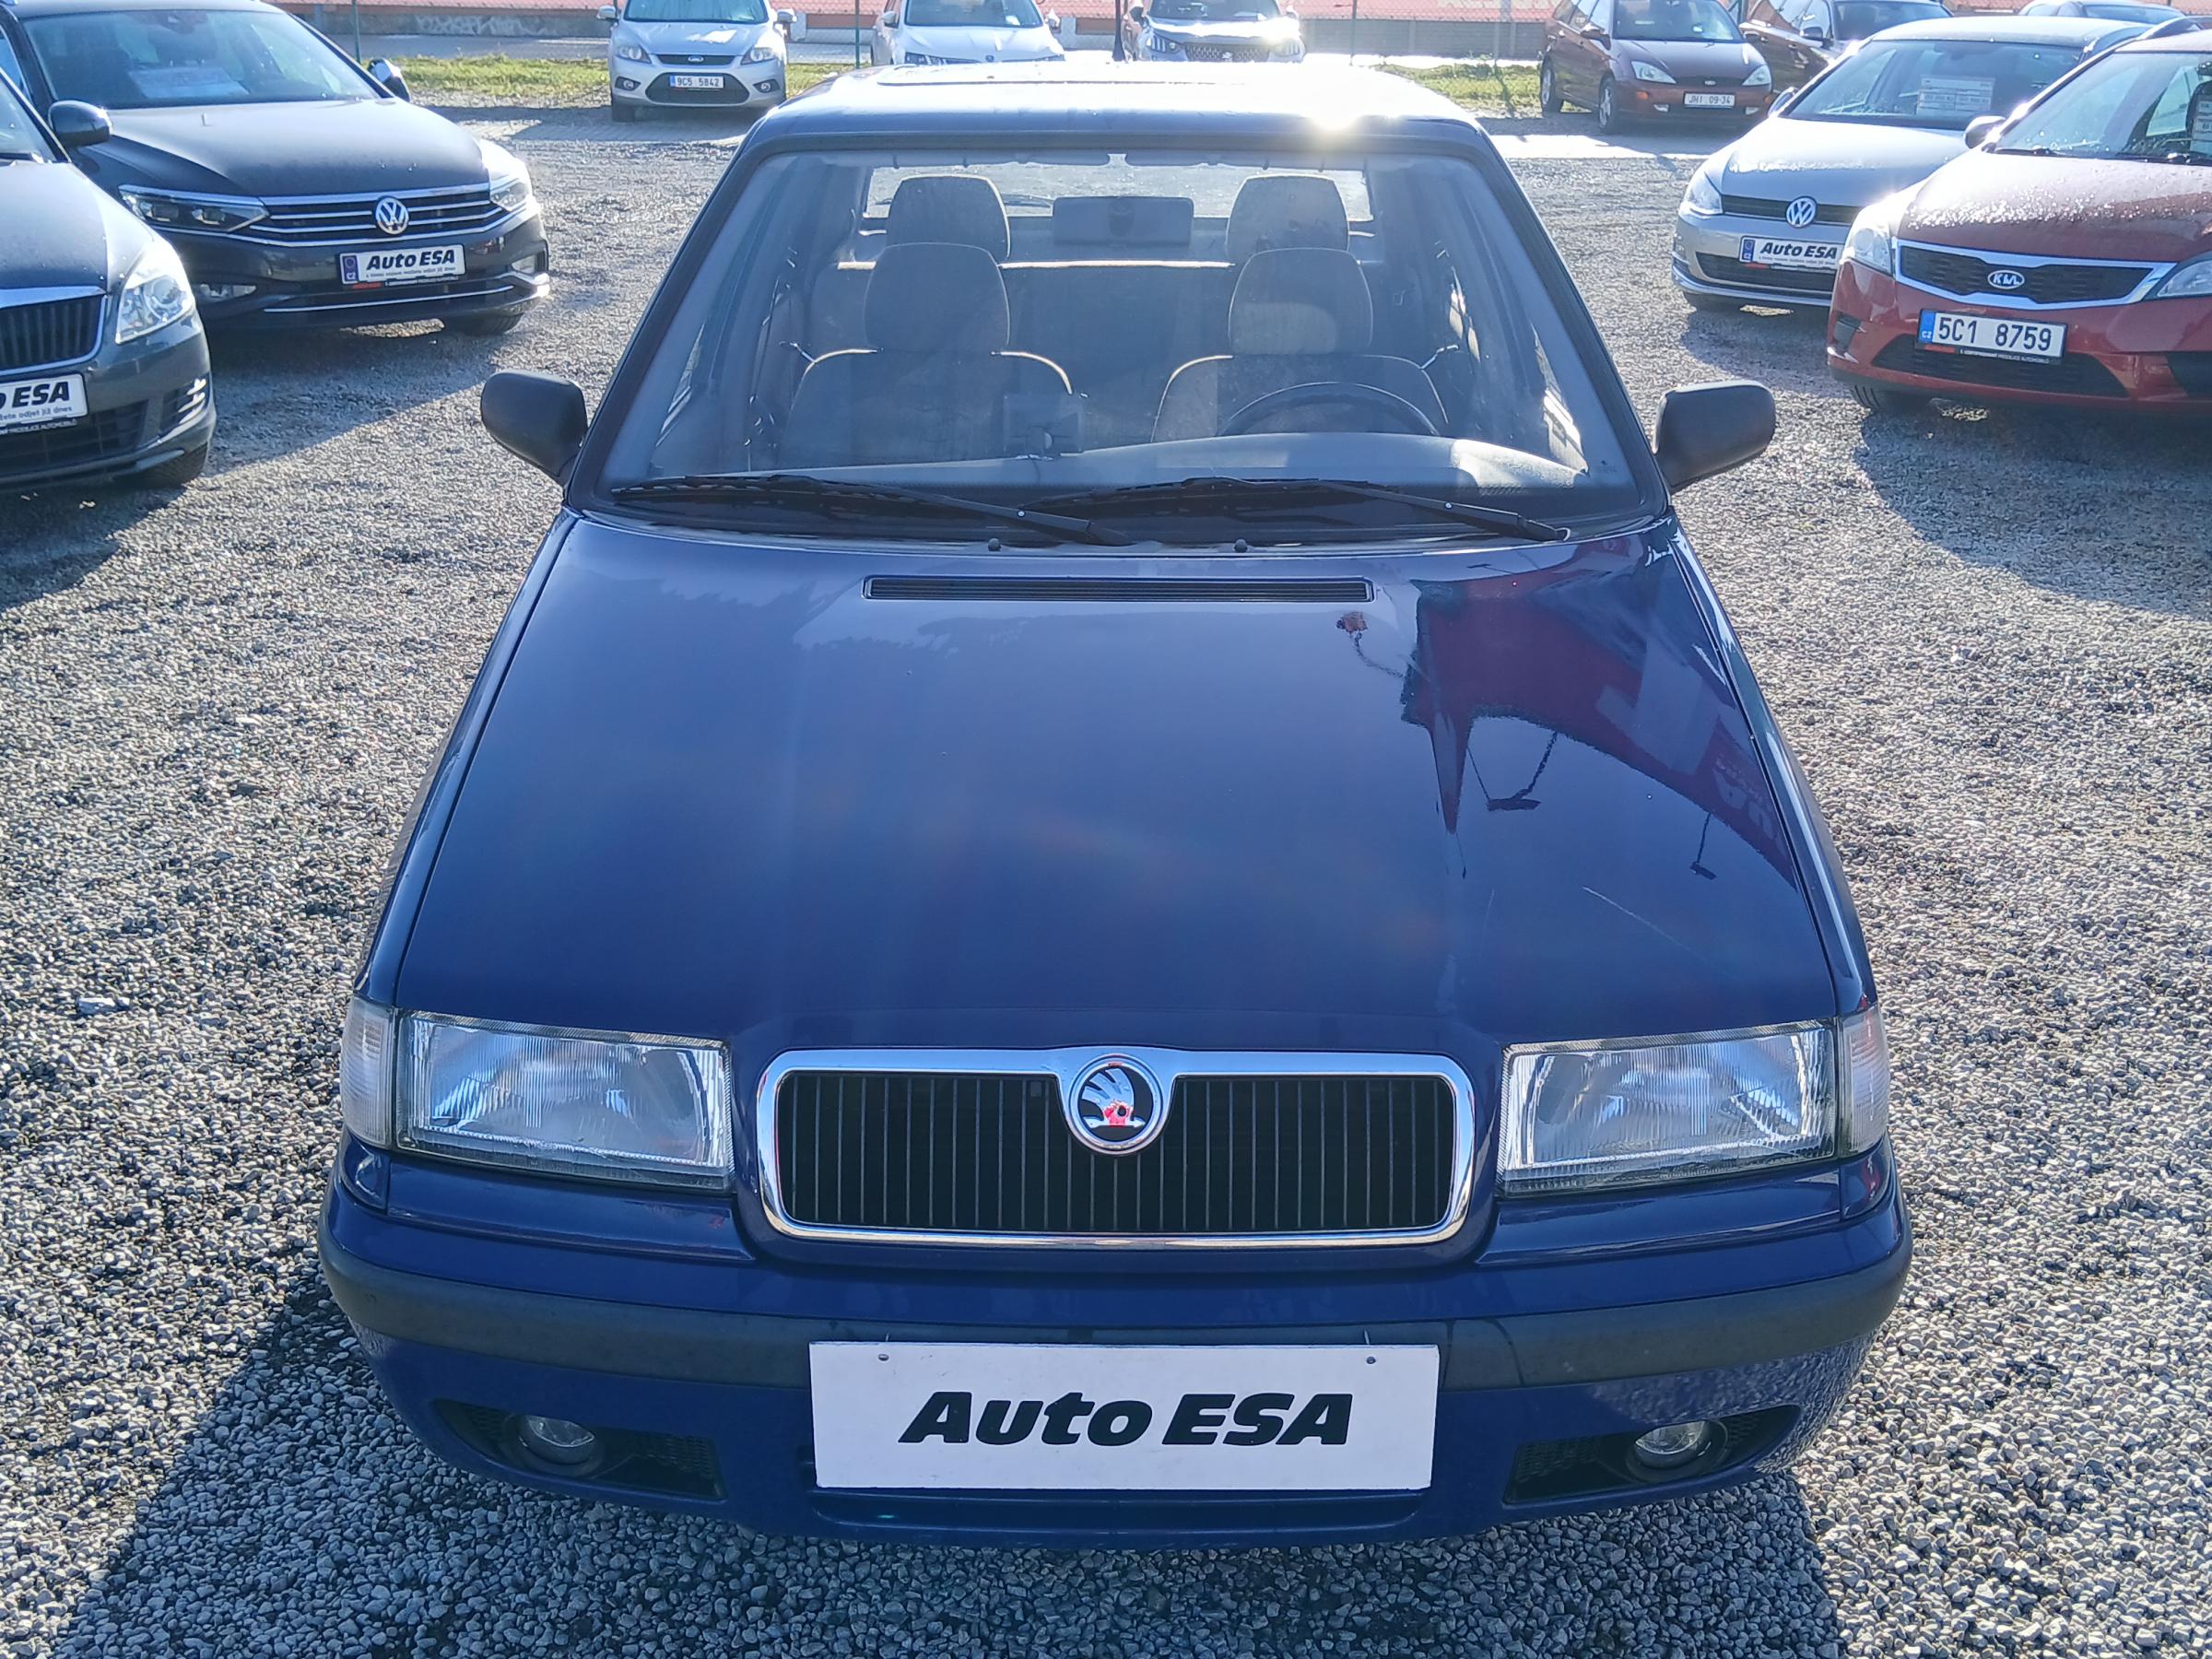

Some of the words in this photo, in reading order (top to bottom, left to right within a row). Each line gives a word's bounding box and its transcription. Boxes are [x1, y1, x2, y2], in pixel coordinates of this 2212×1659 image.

[677, 77, 693, 87] 9C5
[366, 253, 417, 270] Auto
[419, 249, 455, 265] ESA
[1760, 241, 1803, 256] Auto
[1804, 245, 1838, 259] ESA
[1922, 331, 1932, 339] CZ
[1938, 316, 1977, 344] 5C1
[1994, 323, 2052, 351] 8759
[12, 381, 70, 408] ESA
[898, 1391, 1153, 1447] Auto
[1161, 1393, 1353, 1447] ESA
